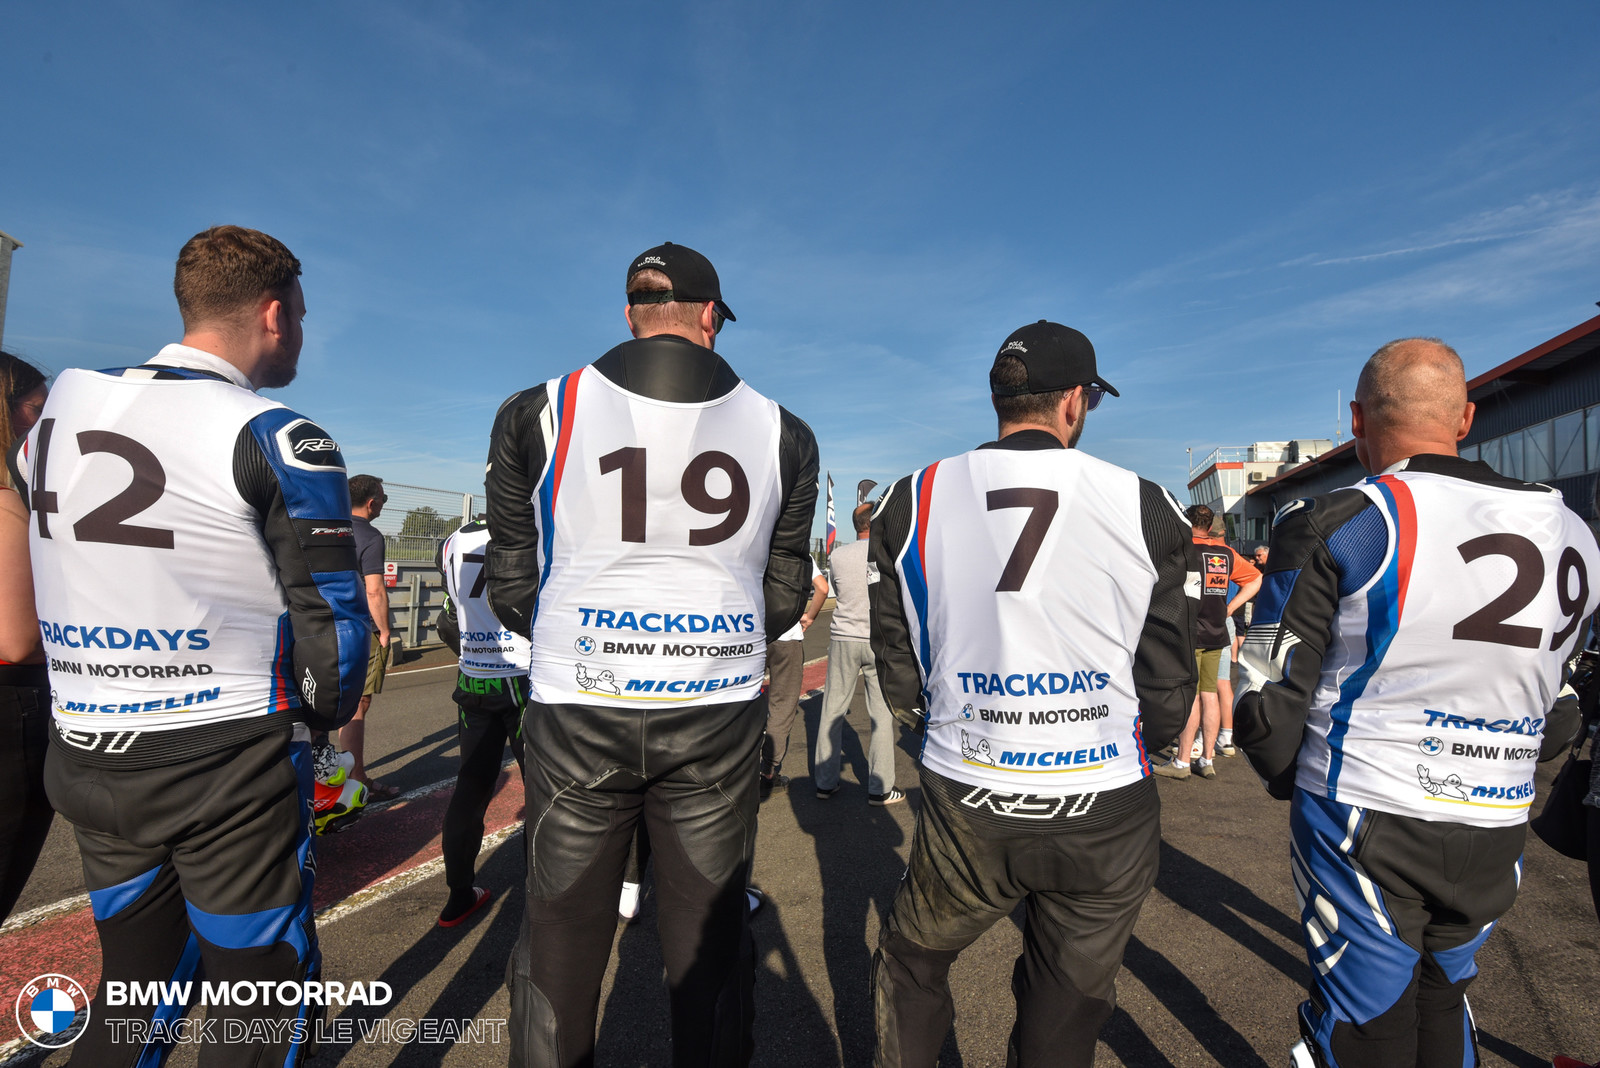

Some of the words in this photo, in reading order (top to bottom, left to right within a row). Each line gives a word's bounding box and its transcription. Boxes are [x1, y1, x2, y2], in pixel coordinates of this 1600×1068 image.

[31, 418, 175, 549] 42
[598, 446, 751, 546] 19
[986, 487, 1059, 592] 7
[449, 553, 487, 598] 17
[1210, 576, 1226, 585] KTM
[1452, 533, 1589, 651] 29
[578, 607, 755, 633] TRACKDAYS
[472, 646, 515, 654] MOTORRAD
[602, 641, 656, 655] BMW
[662, 643, 753, 657] MOTORRAD
[51, 657, 82, 675] BMW
[87, 663, 213, 679] MOTORRAD
[624, 674, 752, 693] MICHELIN
[957, 670, 1111, 697] TRACKDAYS
[65, 686, 221, 713] MICHELIN
[979, 708, 1022, 725] BMW
[1028, 704, 1109, 725] MOTORRAD
[999, 742, 1120, 766] MICHELIN
[1451, 743, 1500, 760] BMW
